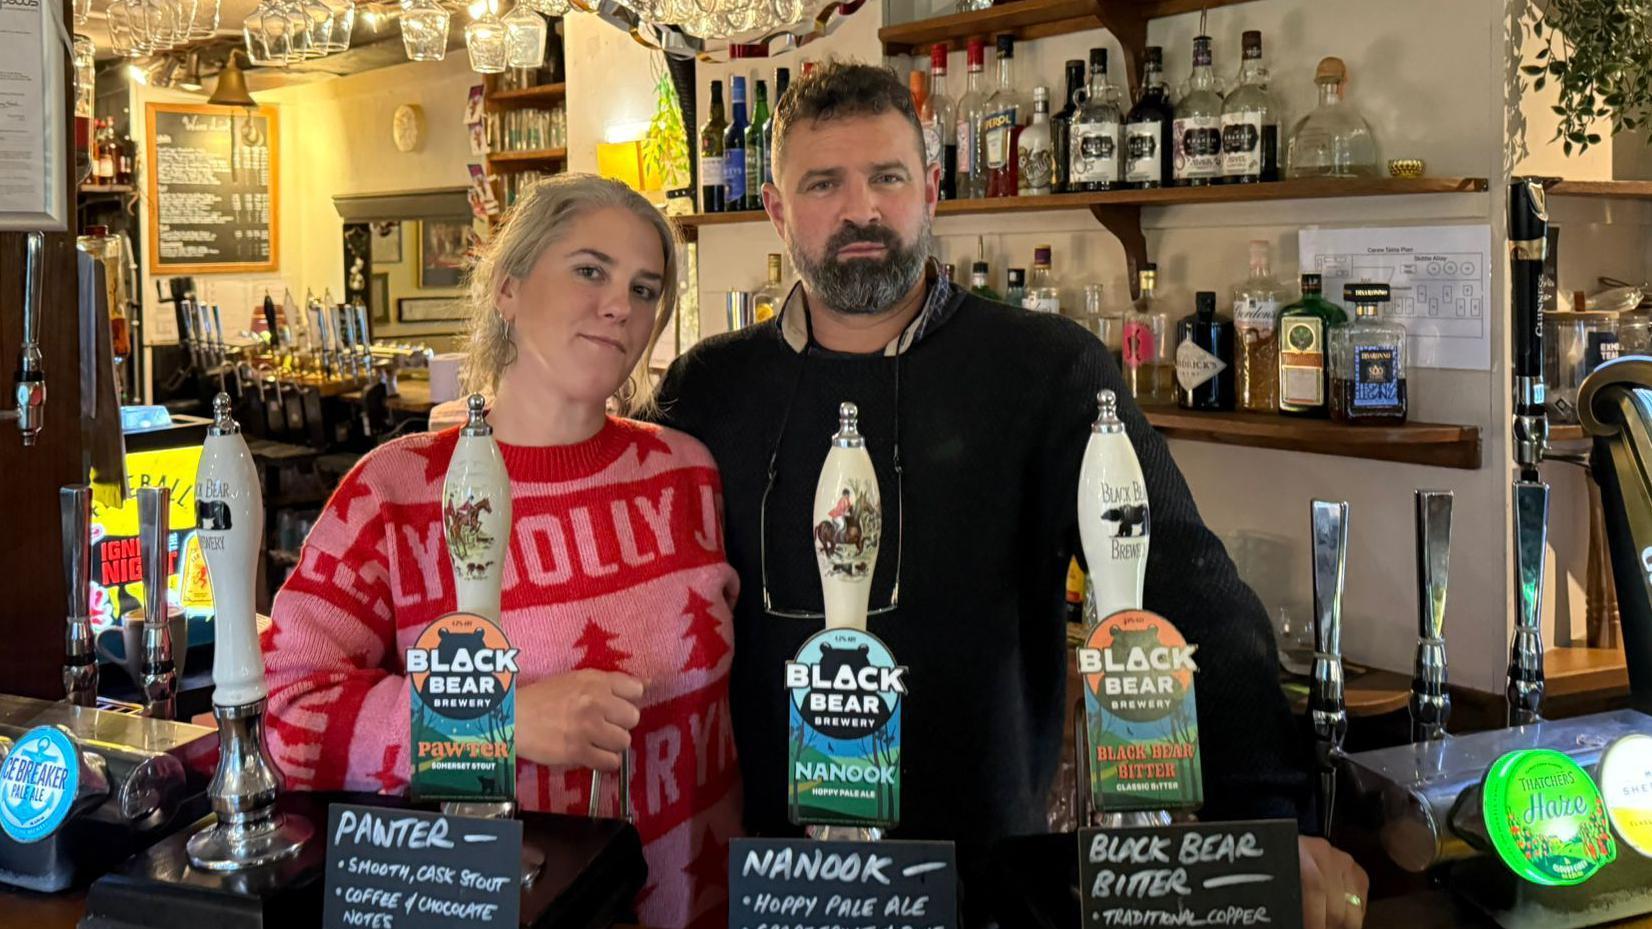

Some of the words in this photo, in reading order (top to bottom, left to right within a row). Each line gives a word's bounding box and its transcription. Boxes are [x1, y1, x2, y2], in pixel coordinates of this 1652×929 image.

[1101, 482, 1131, 503] BLACK
[406, 648, 519, 673] BLACK
[1079, 646, 1198, 673] BLACK
[429, 676, 495, 694] BEAR
[787, 663, 904, 692] BLACK
[1105, 676, 1174, 695] BEAR
[434, 698, 491, 708] BREWERY
[810, 693, 879, 714] BEAR
[1112, 700, 1171, 710] BREWERY
[814, 716, 875, 728] BREWERY
[1097, 744, 1146, 761] BLACK
[1152, 742, 1195, 759] BEAR
[15, 758, 69, 790] BREAKER
[431, 762, 470, 770] SOMERSET
[471, 762, 496, 770] STOUT
[795, 761, 895, 784] NANOOK
[1118, 763, 1176, 779] BITTER
[1116, 782, 1149, 792] CLASSIC
[1518, 770, 1576, 792] THATCHERS
[11, 783, 30, 799] PALE
[30, 786, 45, 802] ALE
[812, 788, 839, 797] HOPPY
[840, 788, 859, 798] PALE
[860, 789, 875, 798] ALE
[1523, 792, 1588, 825] Haze
[1089, 833, 1172, 864] BLACK
[1178, 831, 1264, 865] BEAR
[742, 847, 893, 885] NANOOK
[416, 864, 456, 884] CASK
[459, 869, 511, 892] STOUT
[1091, 868, 1192, 898] BITTER
[345, 886, 402, 909] COFFEE
[418, 896, 498, 921] CHOCOLATE
[753, 893, 818, 917] HOPPY
[825, 894, 878, 917] PALE
[884, 895, 929, 917] ALE
[343, 910, 394, 929] NOTES
[1103, 907, 1206, 926] TRADITIONAL
[1206, 905, 1271, 925] COPPER
